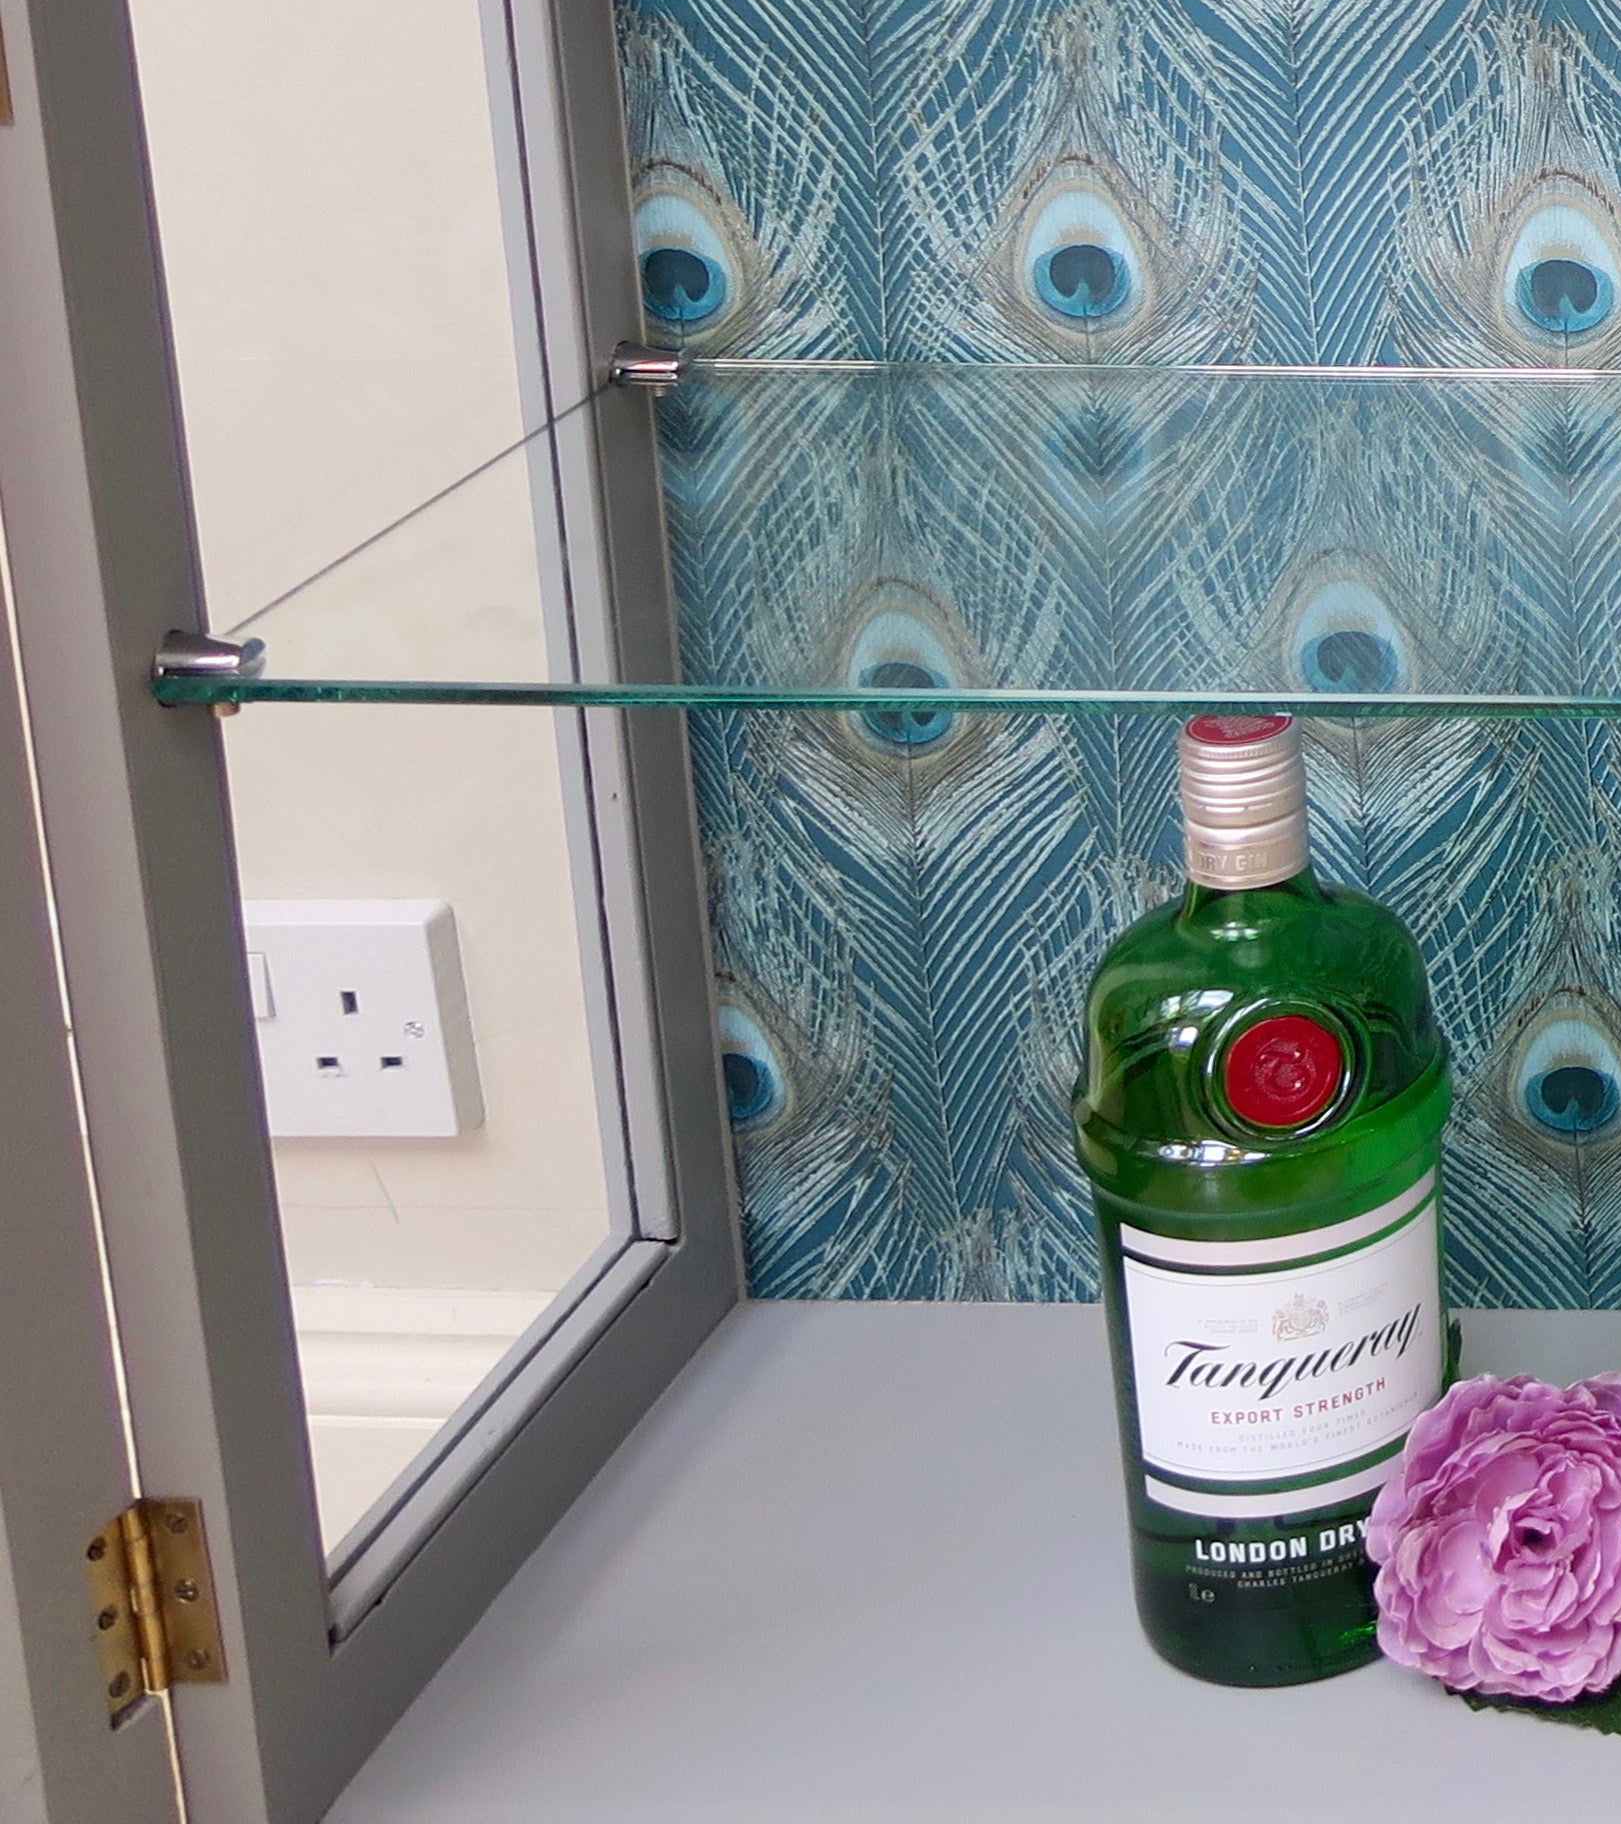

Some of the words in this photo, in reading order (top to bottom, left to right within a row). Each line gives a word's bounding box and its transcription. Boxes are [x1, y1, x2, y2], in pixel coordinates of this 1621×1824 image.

[1165, 1302, 1422, 1401] Tanqueray
[1211, 1408, 1283, 1425] EXPORT
[1293, 1376, 1387, 1418] STRENGTH
[1195, 1537, 1308, 1563] LONDON
[1319, 1516, 1371, 1551] DRY
